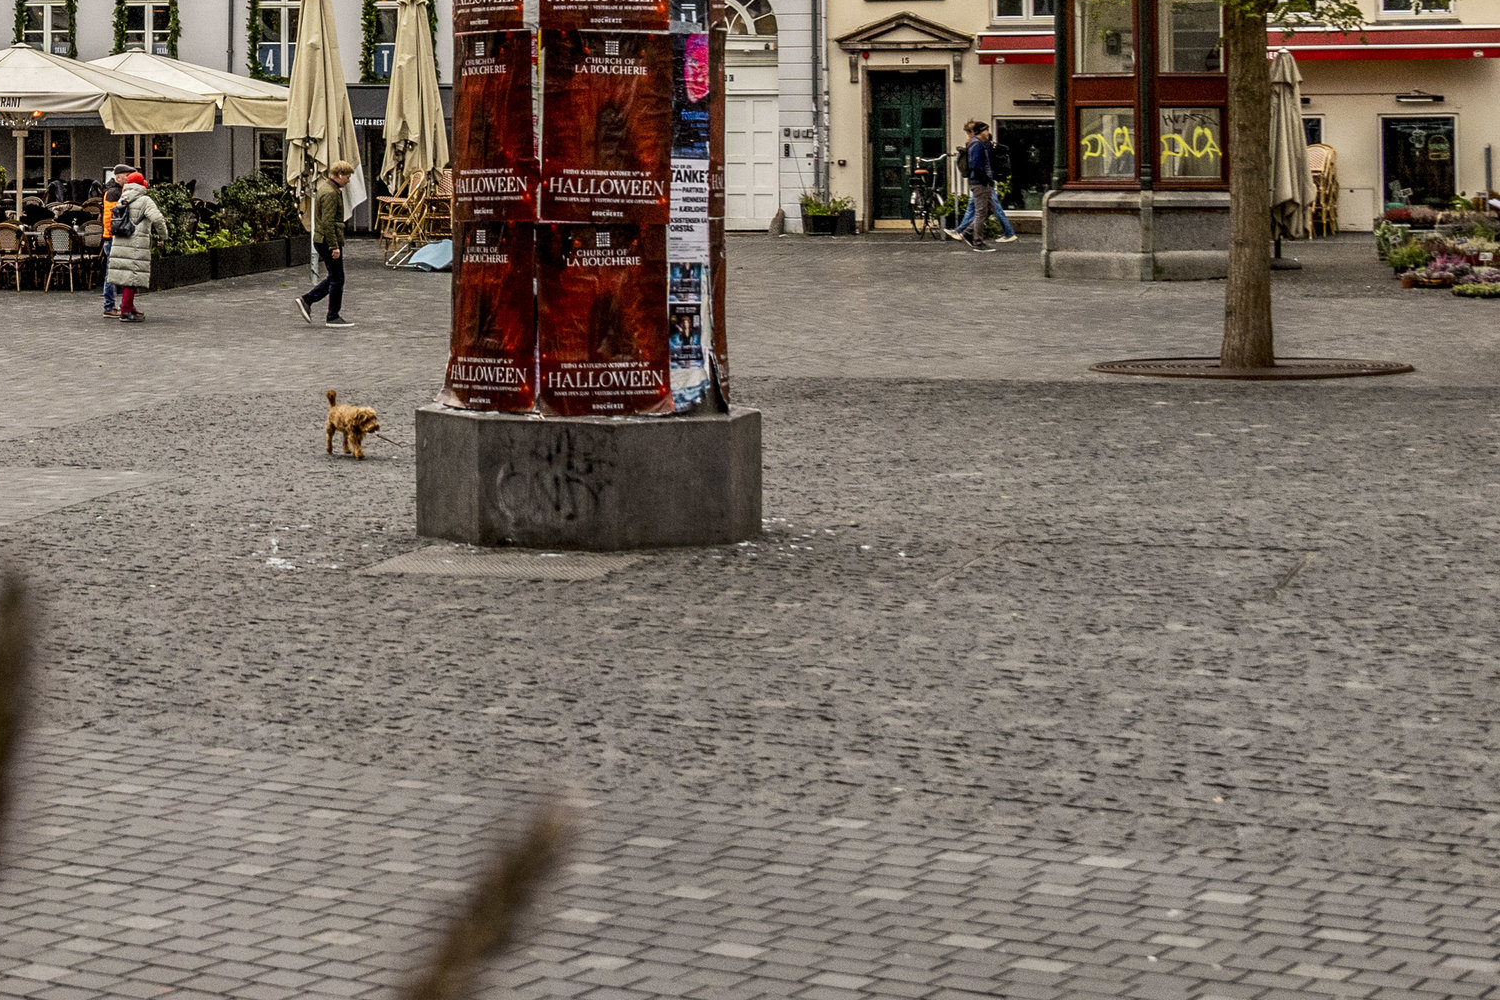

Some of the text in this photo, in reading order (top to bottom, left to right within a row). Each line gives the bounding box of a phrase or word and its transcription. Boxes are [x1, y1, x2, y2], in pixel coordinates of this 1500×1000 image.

[265, 49, 274, 71] 4
[382, 50, 390, 72] T
[468, 64, 506, 75] BOUCHERIE
[575, 65, 648, 75] LA BOUCHERIE
[1081, 126, 1134, 160] DNA
[1160, 126, 1222, 165] DNA
[456, 176, 527, 193] HALLOWEEN
[549, 177, 664, 196] HALLOWEEN
[470, 254, 508, 263] BOUCHERIE
[566, 257, 641, 267] LA BOUCHERIE
[451, 364, 527, 383] HALLOWEEN
[548, 370, 664, 388] HALLOWEEN
